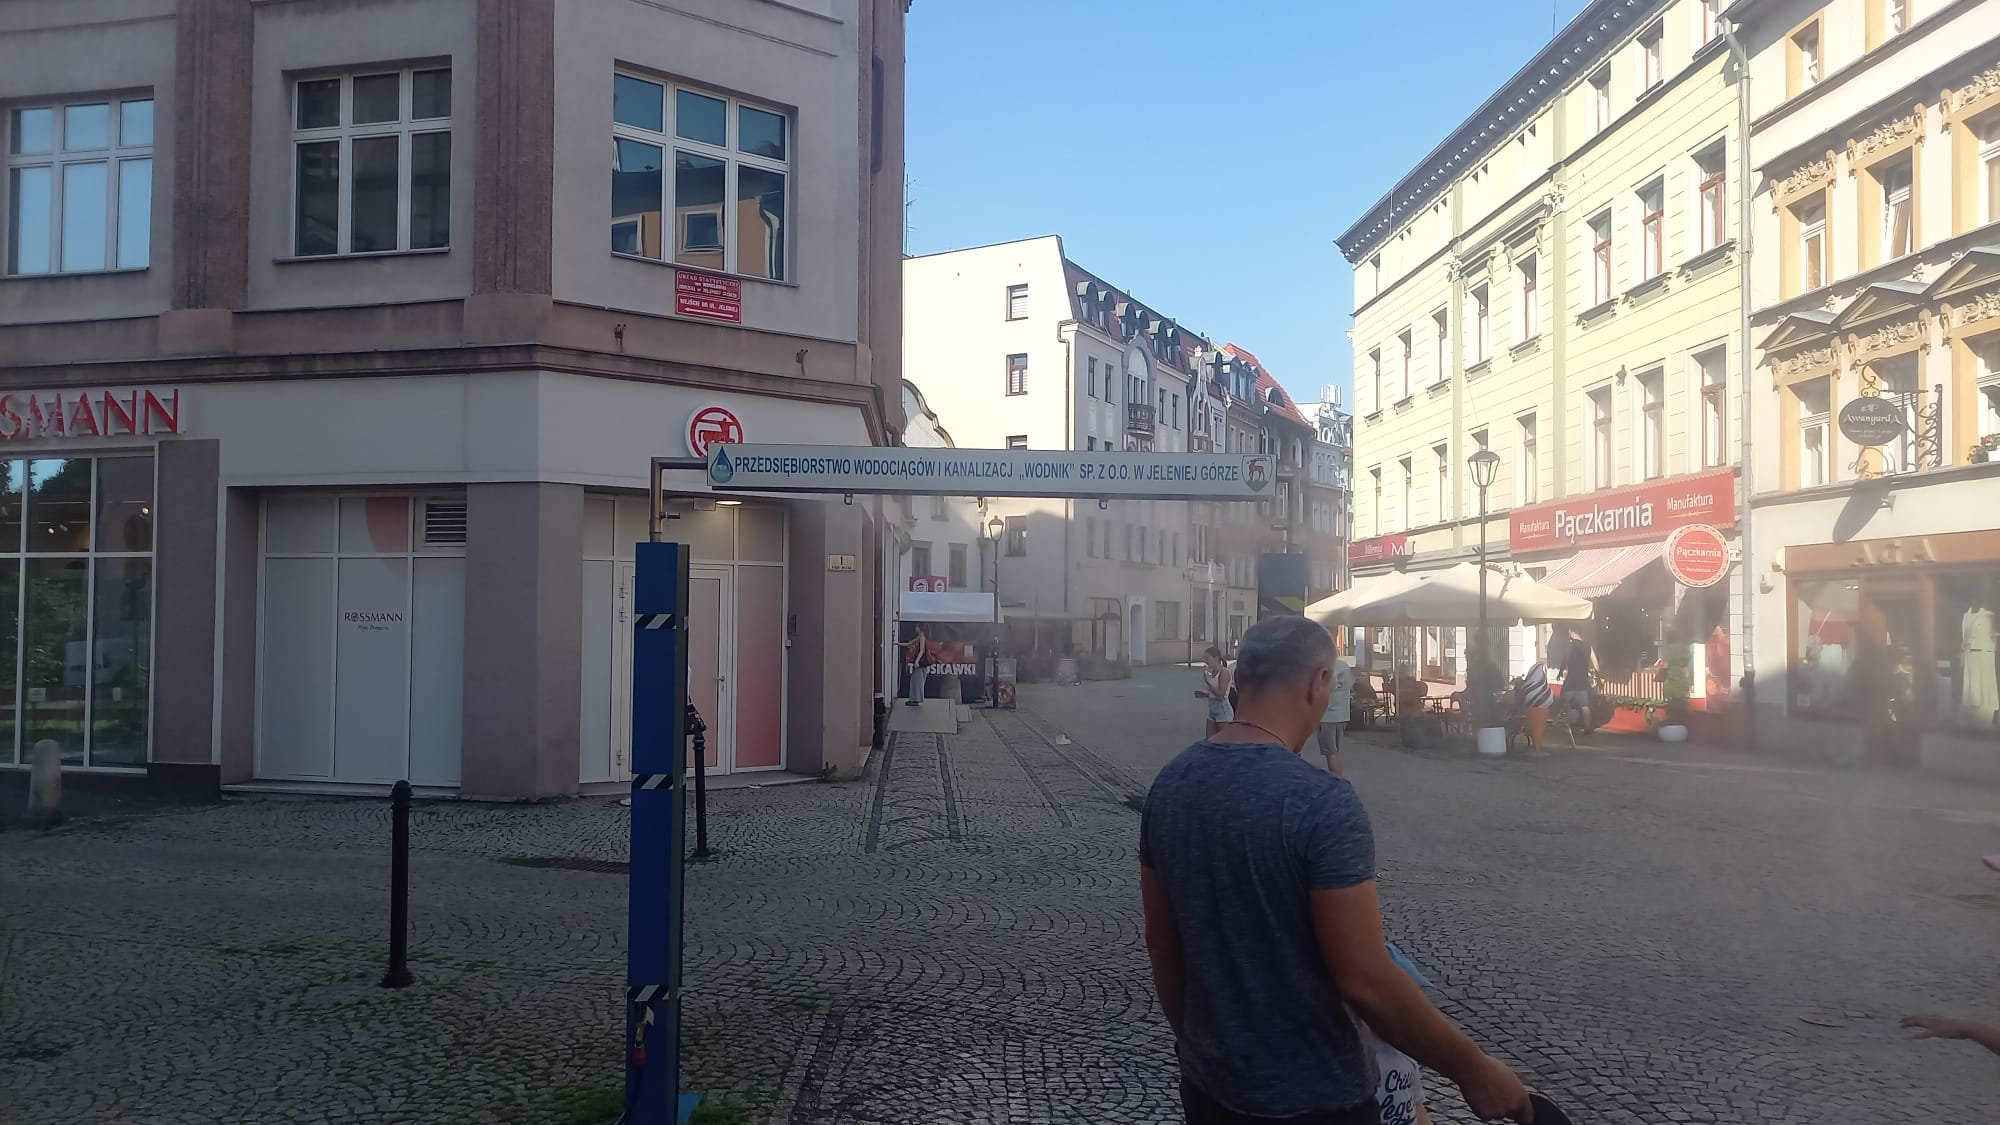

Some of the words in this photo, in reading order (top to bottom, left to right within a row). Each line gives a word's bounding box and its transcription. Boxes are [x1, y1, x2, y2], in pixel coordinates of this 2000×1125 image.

[735, 456, 850, 478] PRZEDSIĘBIORSTWO
[853, 457, 936, 480] WODOCIĄGÓW
[938, 461, 942, 477] I
[1079, 463, 1096, 480] SP.
[1099, 464, 1105, 479] Z
[1108, 464, 1131, 480] O.O.
[1133, 465, 1145, 480] W
[1146, 464, 1198, 481] JELENIEJ
[1200, 462, 1239, 481] GÓRZE
[1666, 492, 1714, 512] Manufaktura
[1519, 519, 1551, 534] Manufaktura
[1555, 496, 1654, 544] Pączkarnia
[1676, 546, 1722, 559] Pączkarnia
[344, 612, 403, 622] ROSSMANN
